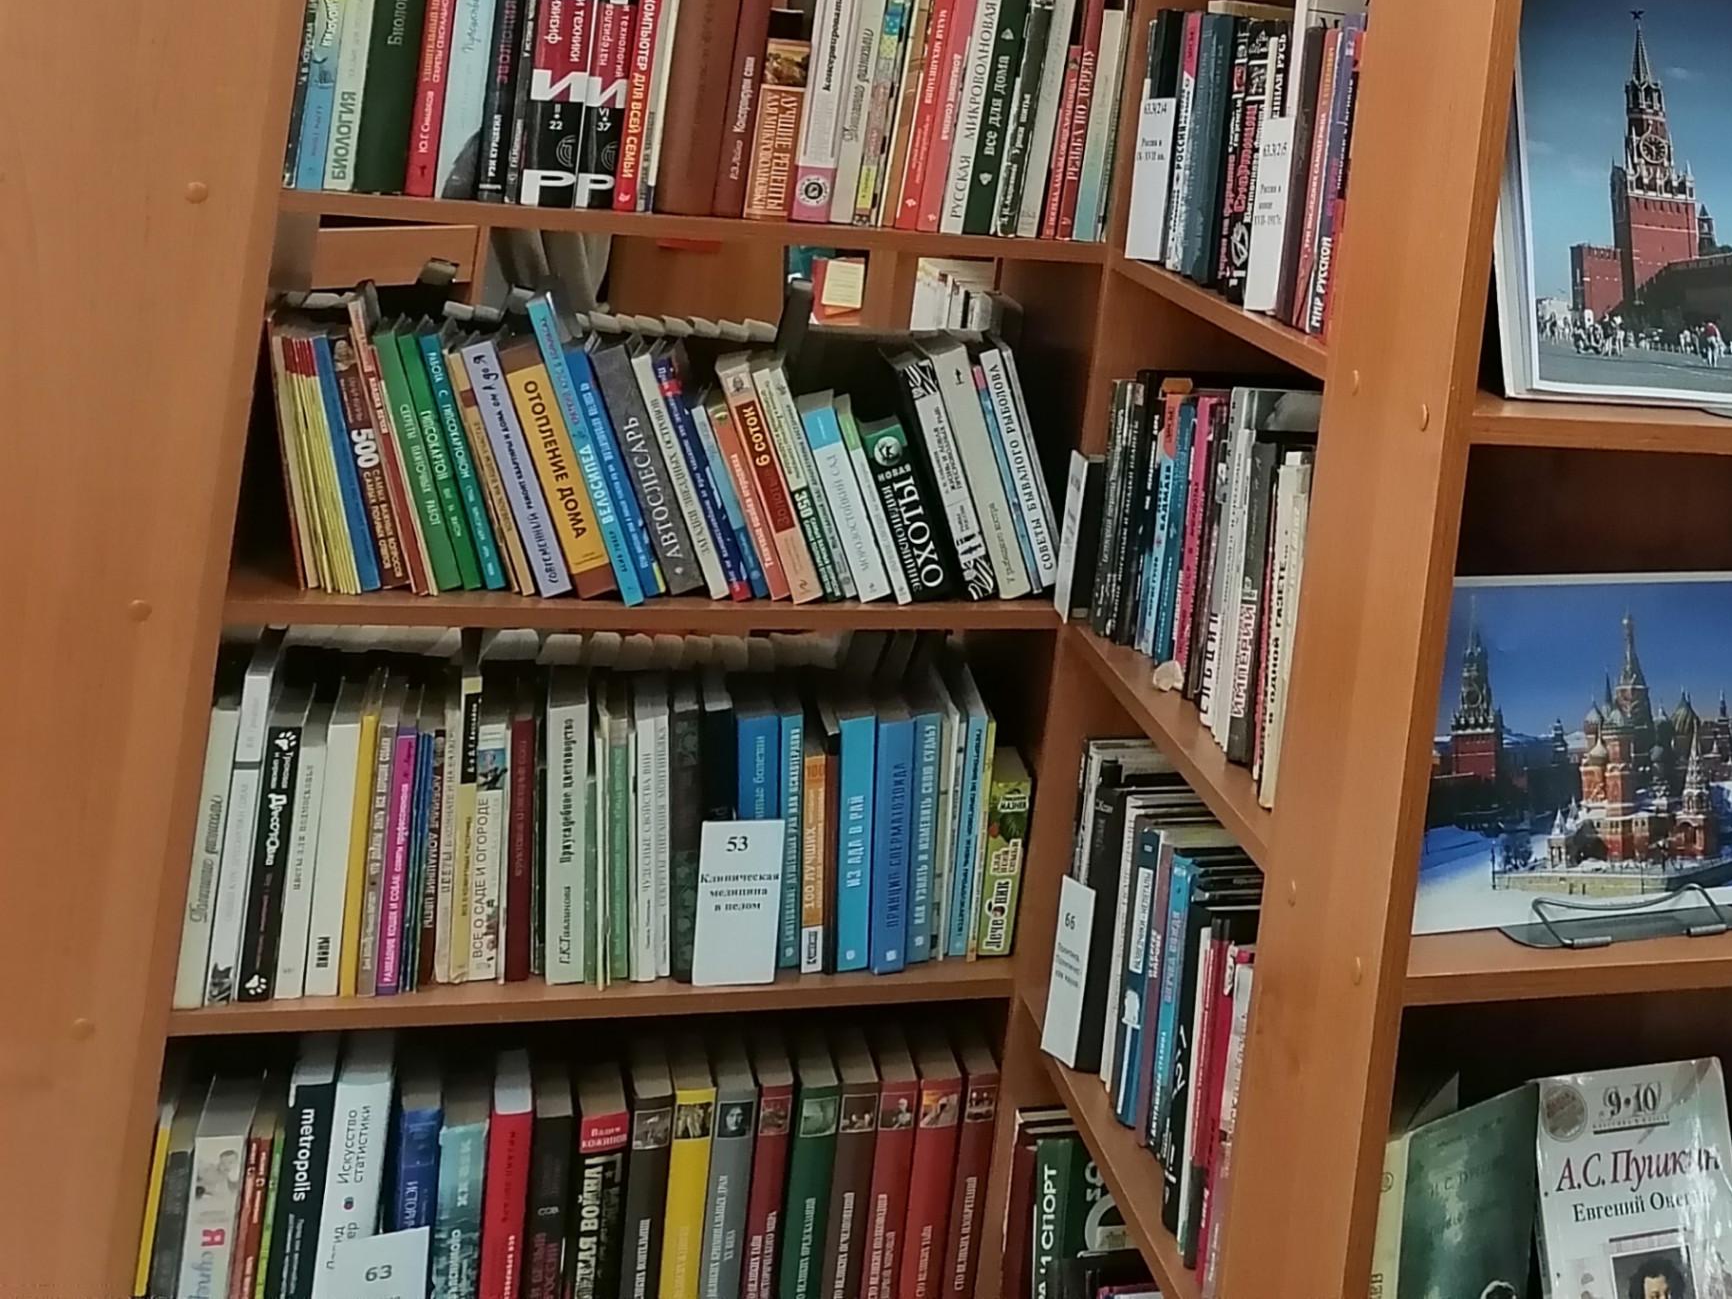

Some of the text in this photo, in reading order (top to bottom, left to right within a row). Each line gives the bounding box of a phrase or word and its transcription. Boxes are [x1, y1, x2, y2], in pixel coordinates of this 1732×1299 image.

[496, 0, 518, 85] ЭВОЛЮЦИЯ
[569, 10, 584, 63] техники
[597, 4, 614, 68] материалов
[614, 15, 629, 79] технологий
[631, 73, 646, 98] ДЛЯ
[993, 55, 1010, 94] дома
[329, 91, 357, 181] БИОЛОГИЯ
[549, 120, 563, 132] 22
[628, 101, 643, 134] ВСЕЙ
[950, 155, 972, 219] РУССКАЯ
[964, 1, 997, 140] МИКРОВОЛНОВАЯ
[986, 98, 1003, 128] для
[1066, 49, 1095, 180] РЕЗЬБА ПО ДЕРЕВУ
[622, 137, 639, 179] СЕМЬИ
[752, 93, 779, 209] ДЛЯ МИКРОВОЛНОВКИ
[767, 93, 797, 210] ЛУЧШИЕ РЕЦЕПТЫ
[350, 428, 380, 468] 500
[523, 380, 587, 539] ОТОПЛЕНИЕ ДОМА
[743, 406, 767, 453] соток
[755, 455, 770, 466] 6
[577, 443, 615, 525] ВЕЛОСИПЕД
[623, 416, 684, 560] АВТОСЛЕСАРЬ
[989, 363, 1053, 570] СОВЕТЫ БЫВАЛОГО РЫБОЛОВА
[795, 490, 814, 518] 350
[894, 476, 945, 588] ОХОТЫ
[1230, 604, 1256, 718] ИМПЕРИЙ
[921, 725, 937, 762] СУДЬБУ
[920, 765, 934, 794] СВОЮ
[726, 835, 749, 852] 53
[846, 795, 865, 887] ИЗ АДА В РАЙ
[887, 762, 906, 928] ПРИНЦИП СПЕРМАТОЗОИДА
[472, 798, 490, 959] ВСЕ О САДЕ И ОГОРОДЕ
[700, 871, 780, 885] Клиническая
[709, 886, 769, 898] медицина
[292, 1108, 317, 1202] metropolis
[336, 1109, 358, 1185] Искусство
[353, 1105, 372, 1183] статистики
[403, 1180, 419, 1228] ИСТОРИ
[577, 1166, 603, 1232] ВОЙНА
[1040, 1164, 1060, 1247] СПОРТ
[1572, 1201, 1648, 1224] Евгений
[365, 1264, 393, 1282] 63
